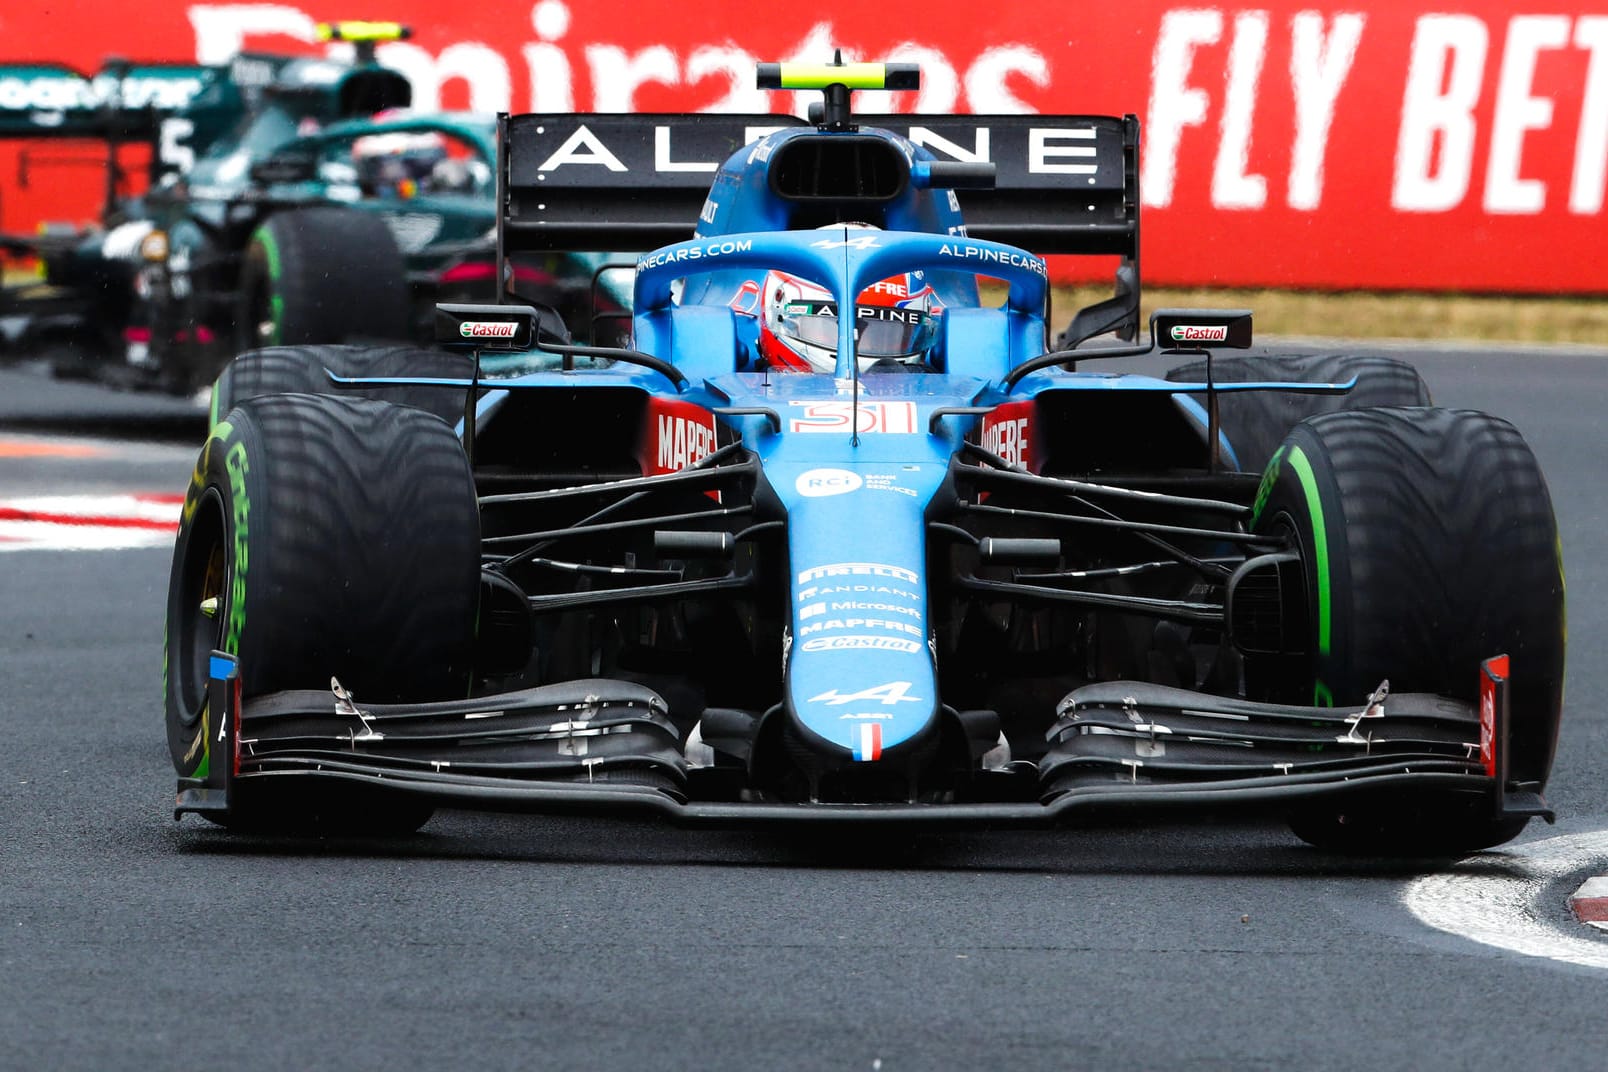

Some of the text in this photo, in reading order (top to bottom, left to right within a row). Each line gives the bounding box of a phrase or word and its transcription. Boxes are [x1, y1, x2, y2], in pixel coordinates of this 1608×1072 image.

[1143, 10, 1608, 215] FLY BET
[160, 118, 194, 175] 5
[537, 124, 1097, 173] ALNE
[939, 244, 1048, 278] ALPINECARS
[816, 305, 919, 325] APINE
[472, 323, 513, 336] Castrol
[1185, 327, 1224, 340] Castrol
[788, 400, 918, 433] 31
[798, 562, 919, 585] PIRELLI
[831, 601, 921, 620] Microsoft
[800, 618, 921, 637] MAPFRE
[831, 637, 915, 651] Castrol
